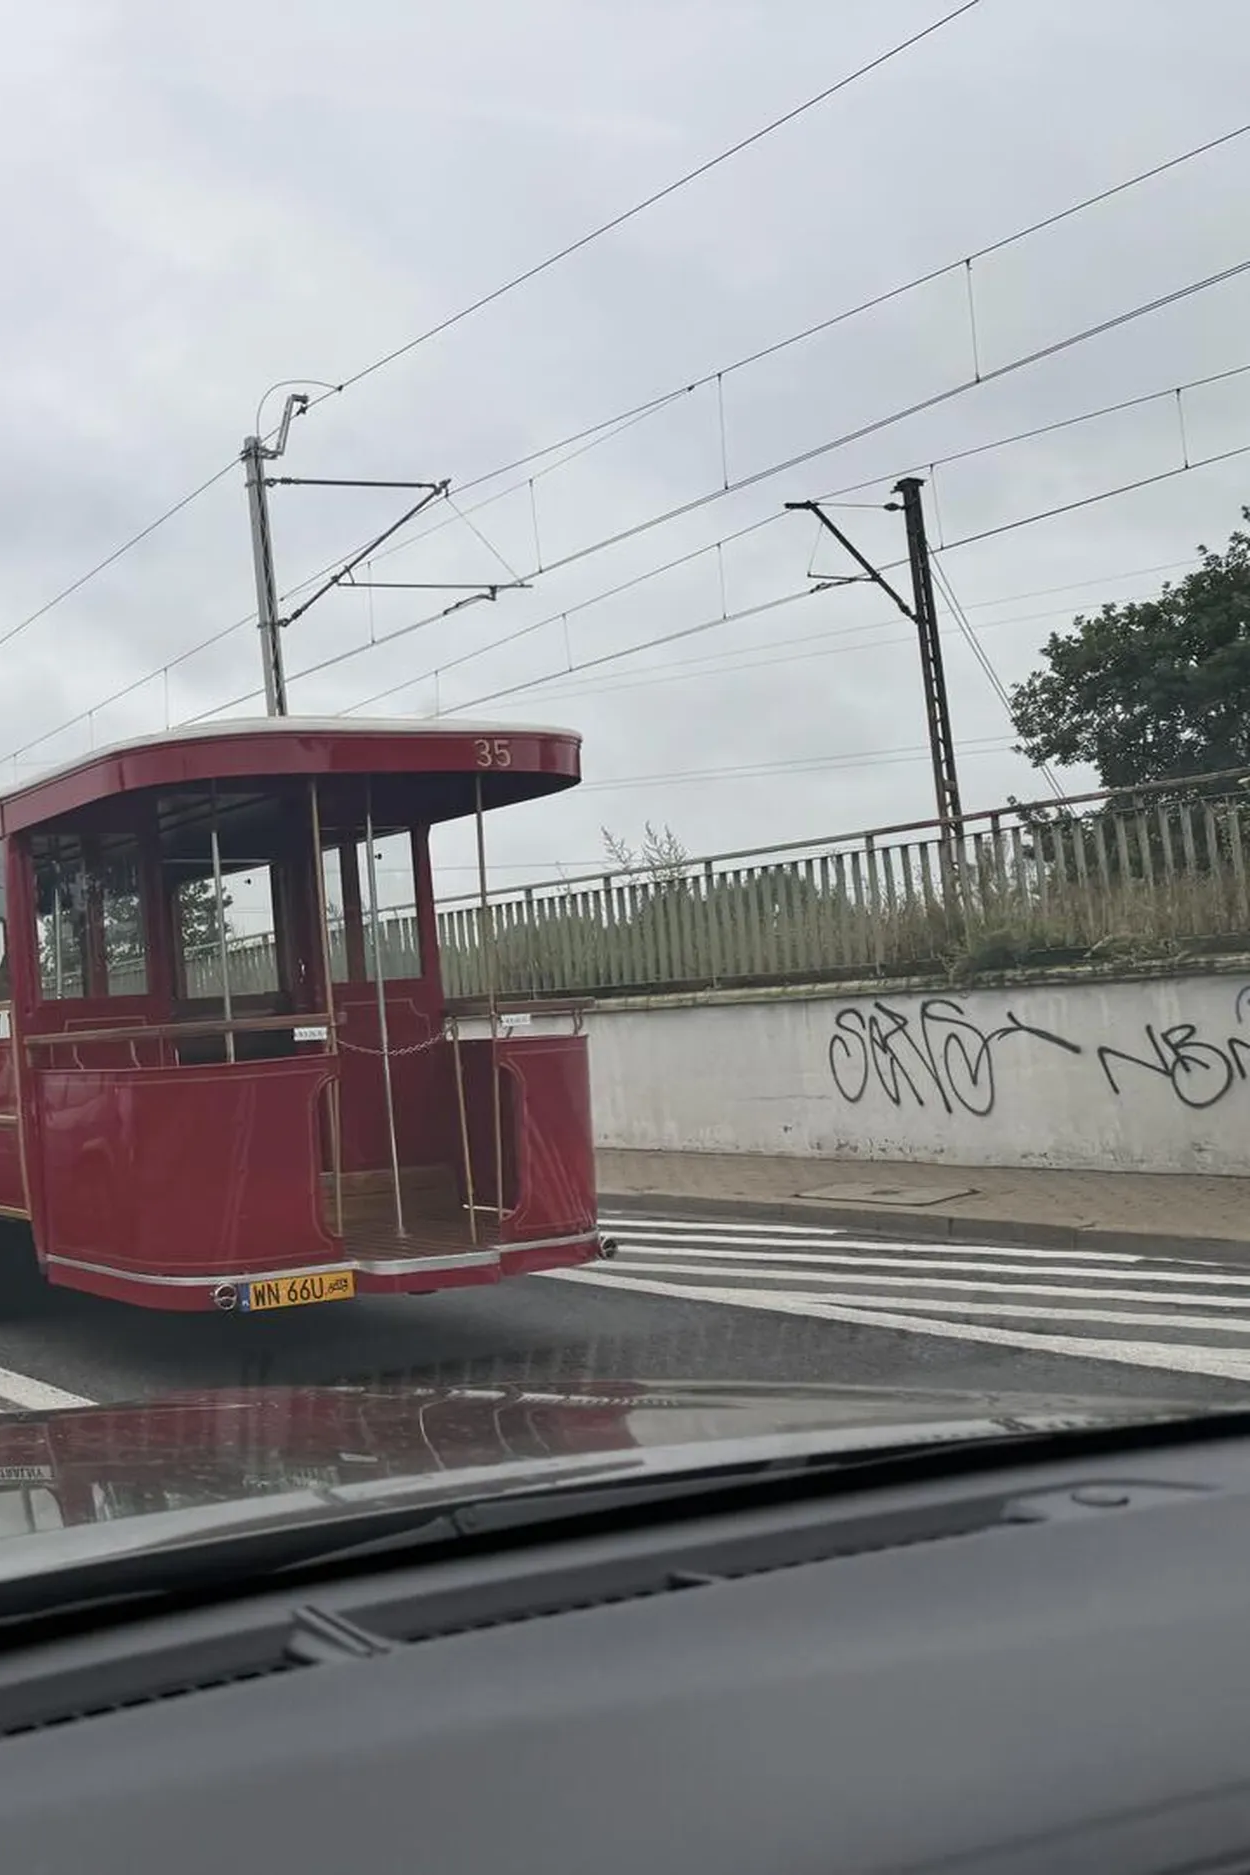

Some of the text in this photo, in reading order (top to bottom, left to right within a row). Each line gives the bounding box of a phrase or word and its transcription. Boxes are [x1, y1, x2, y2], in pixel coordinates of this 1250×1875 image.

[474, 739, 511, 767] 35
[253, 1277, 324, 1307] WN 66U
